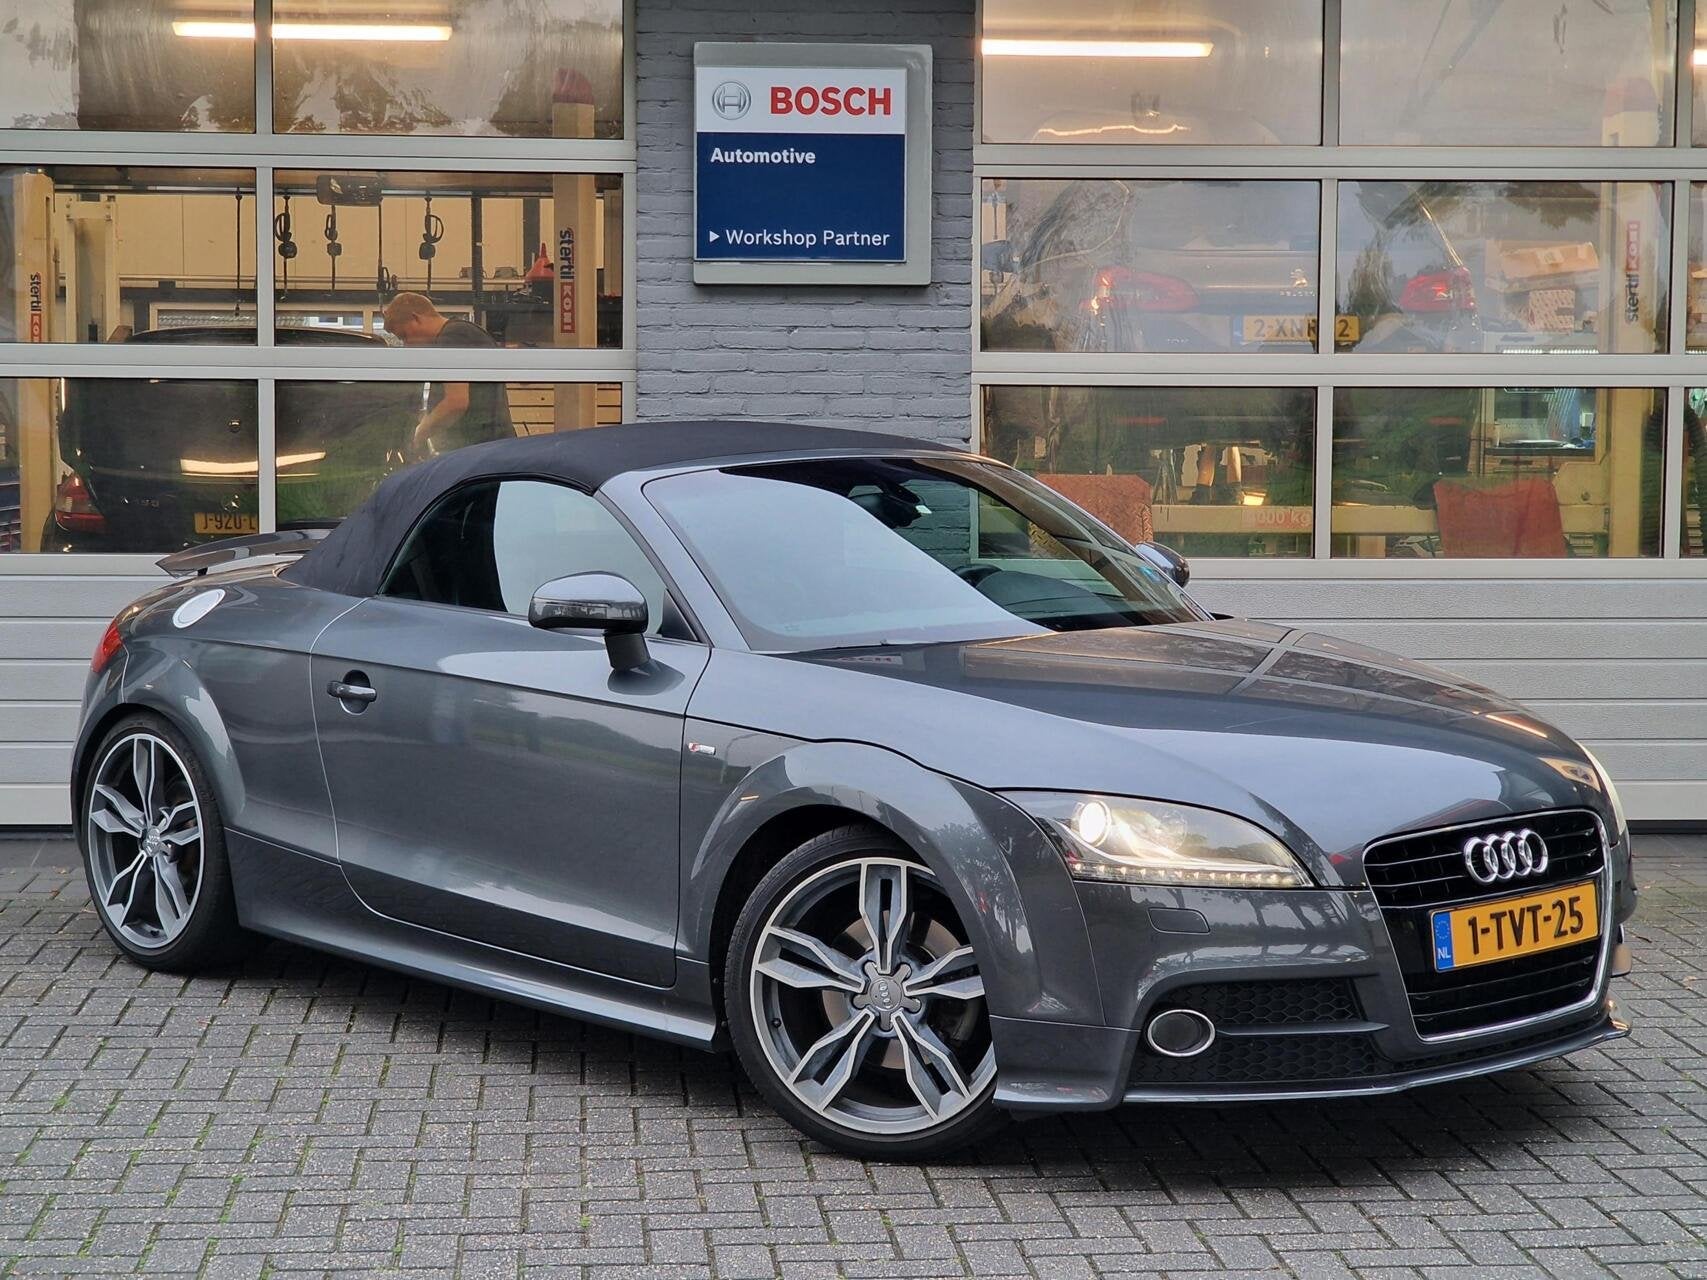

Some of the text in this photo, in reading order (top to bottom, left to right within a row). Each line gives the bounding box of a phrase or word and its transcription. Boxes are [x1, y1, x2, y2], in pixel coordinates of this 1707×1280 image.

[770, 86, 891, 116] BOSCH
[710, 147, 816, 164] Automotive
[559, 229, 575, 280] stertil
[725, 229, 891, 249] Workshop Partner
[30, 273, 42, 311] stertil
[1625, 272, 1639, 322] stertil
[1467, 895, 1584, 955] 1-TVT-25
[1436, 946, 1451, 960] NL
